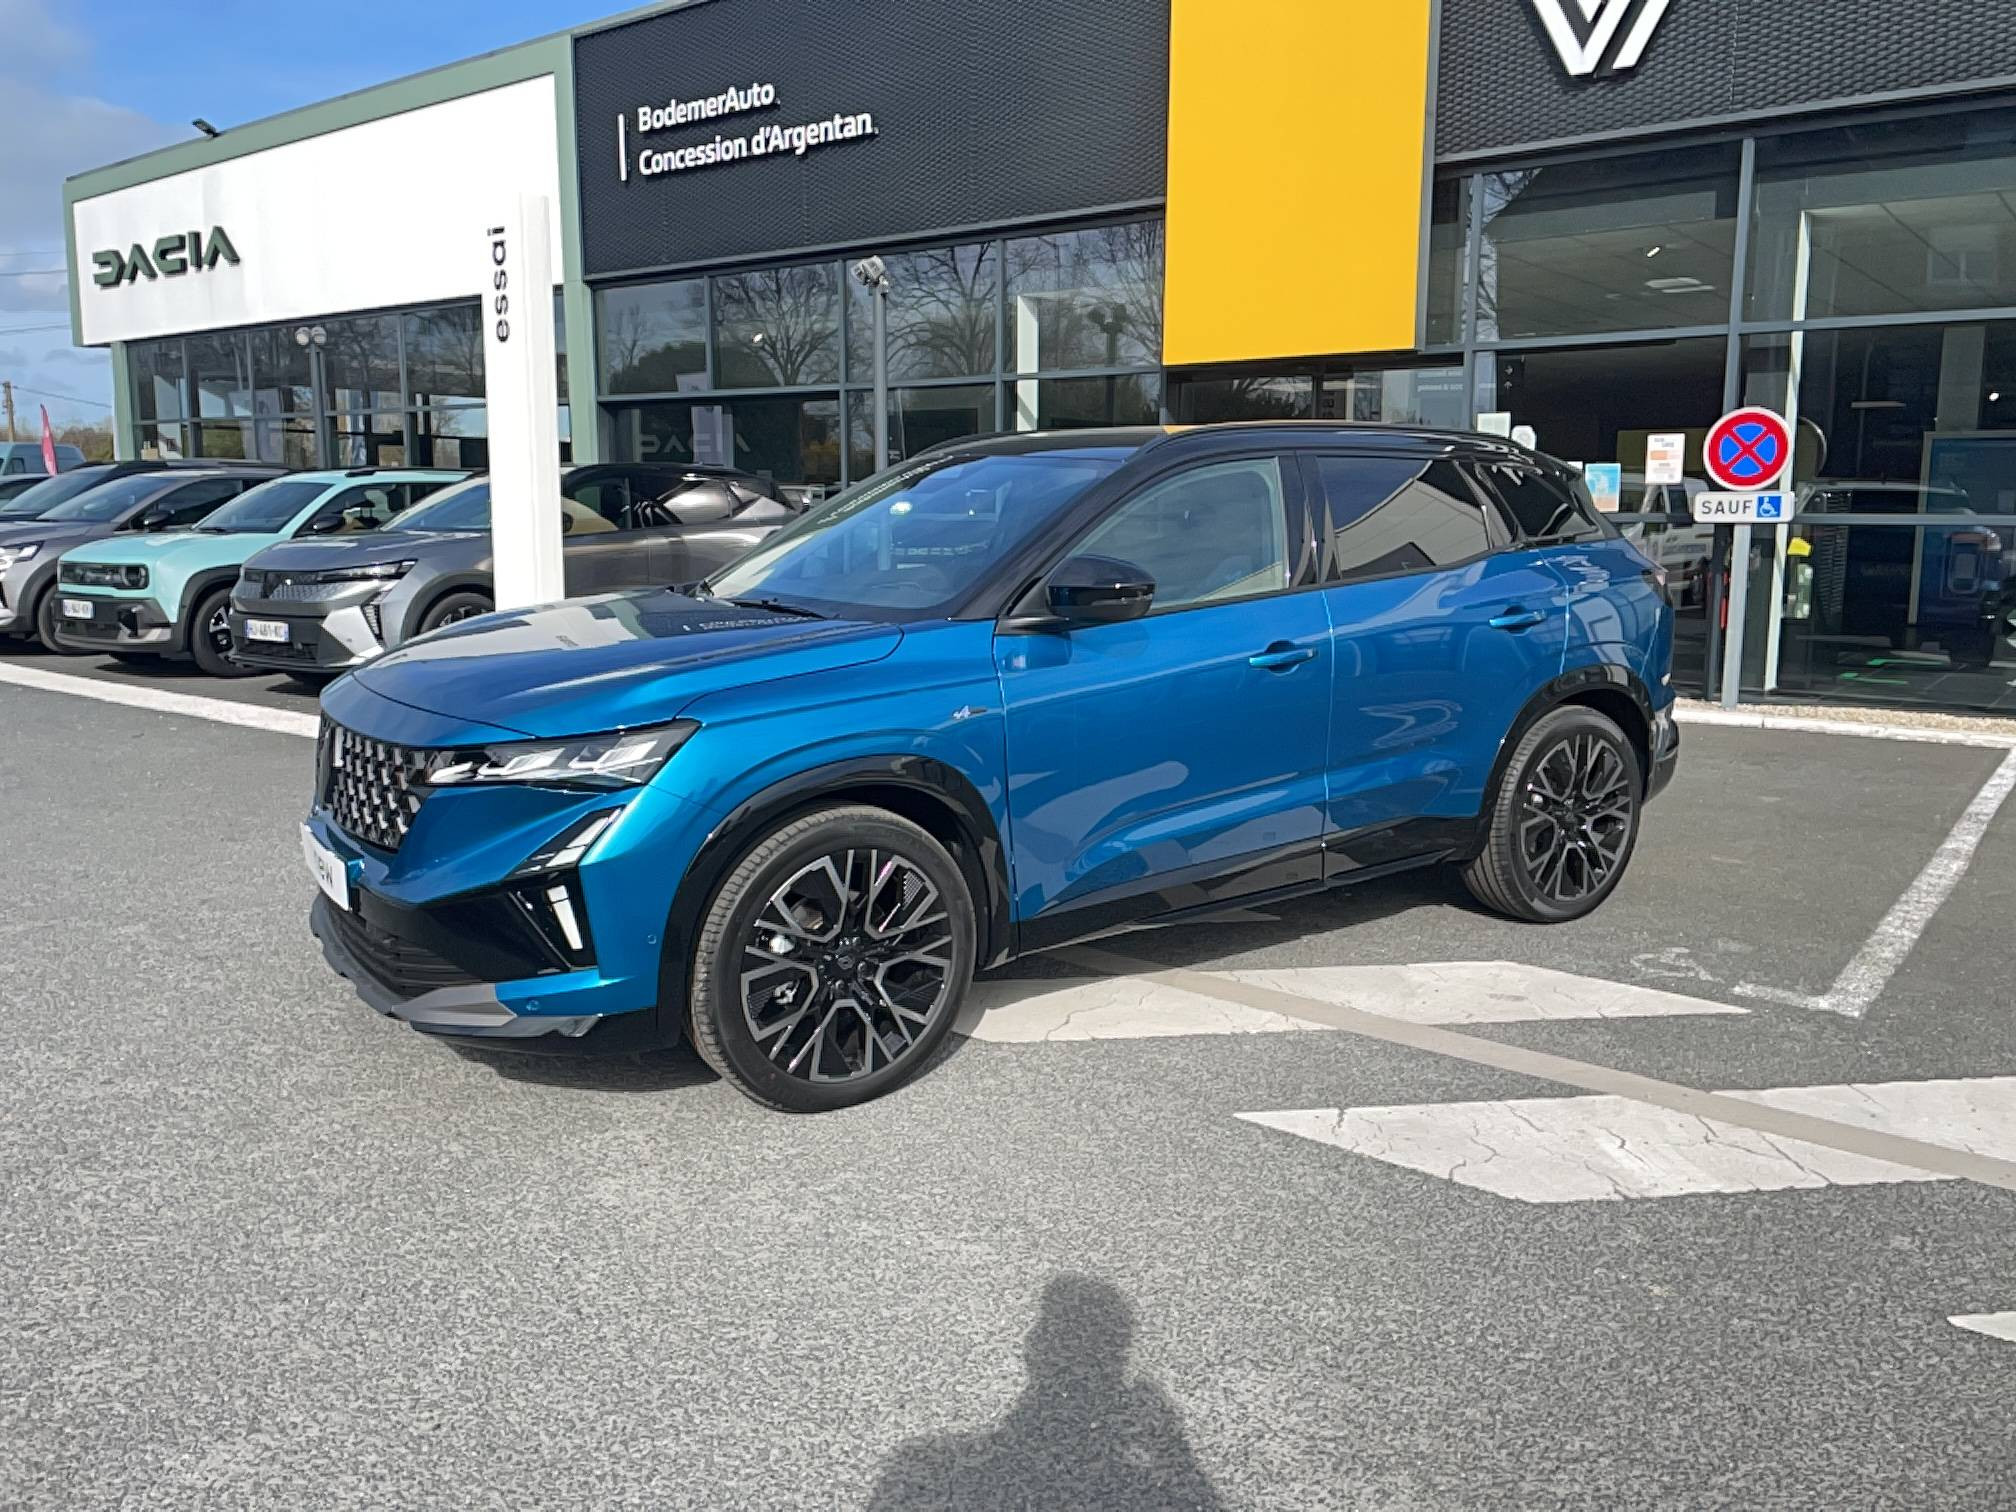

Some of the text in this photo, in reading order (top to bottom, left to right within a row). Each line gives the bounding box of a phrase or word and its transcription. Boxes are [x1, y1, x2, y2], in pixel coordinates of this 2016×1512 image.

[638, 82, 775, 132] BodemerAuto
[639, 113, 872, 175] Concession d'Argentan
[93, 225, 240, 287] DACIA
[487, 226, 510, 342] essai
[1702, 500, 1752, 515] SAUF
